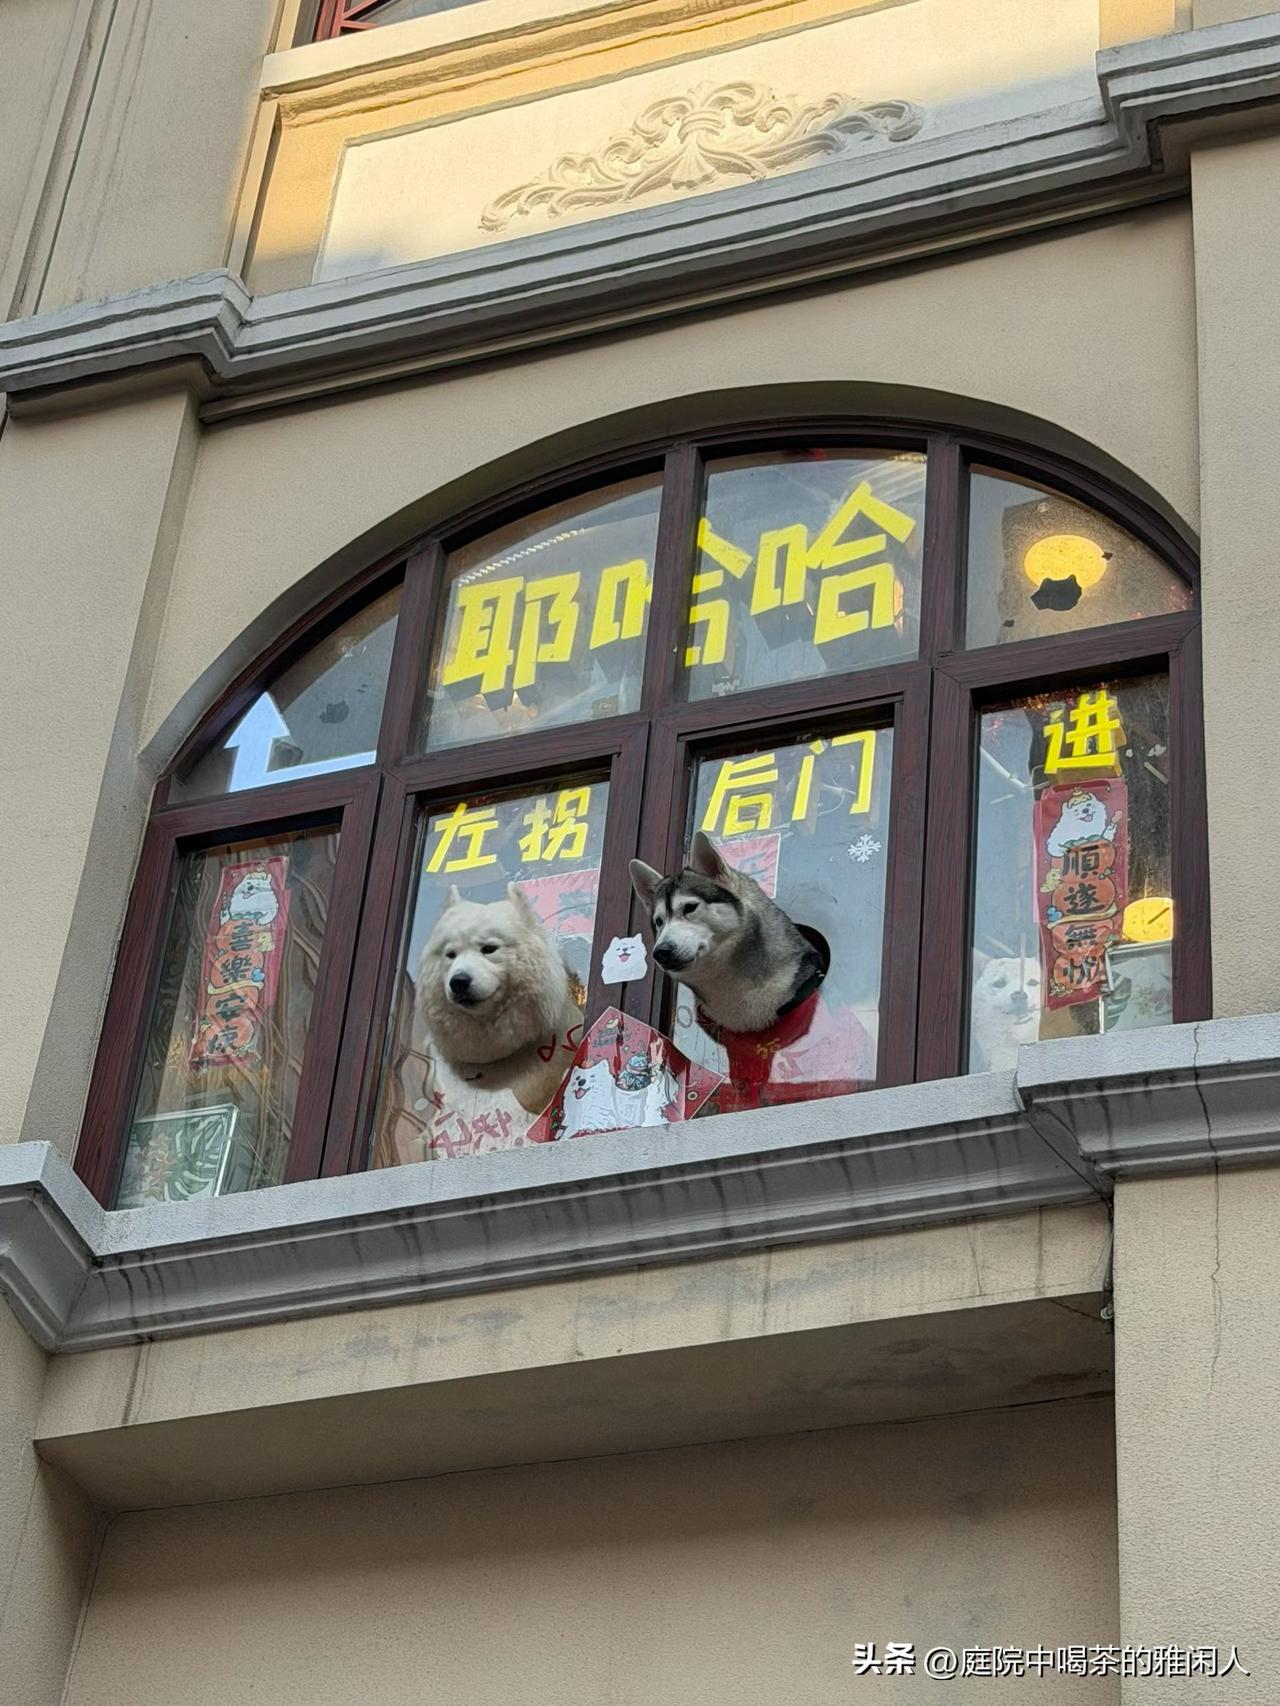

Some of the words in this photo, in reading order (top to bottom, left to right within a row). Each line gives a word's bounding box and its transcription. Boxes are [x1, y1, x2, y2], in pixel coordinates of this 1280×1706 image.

[427, 786, 591, 873] 左拐
[702, 730, 877, 837] 后门
[1043, 689, 1120, 775] 进
